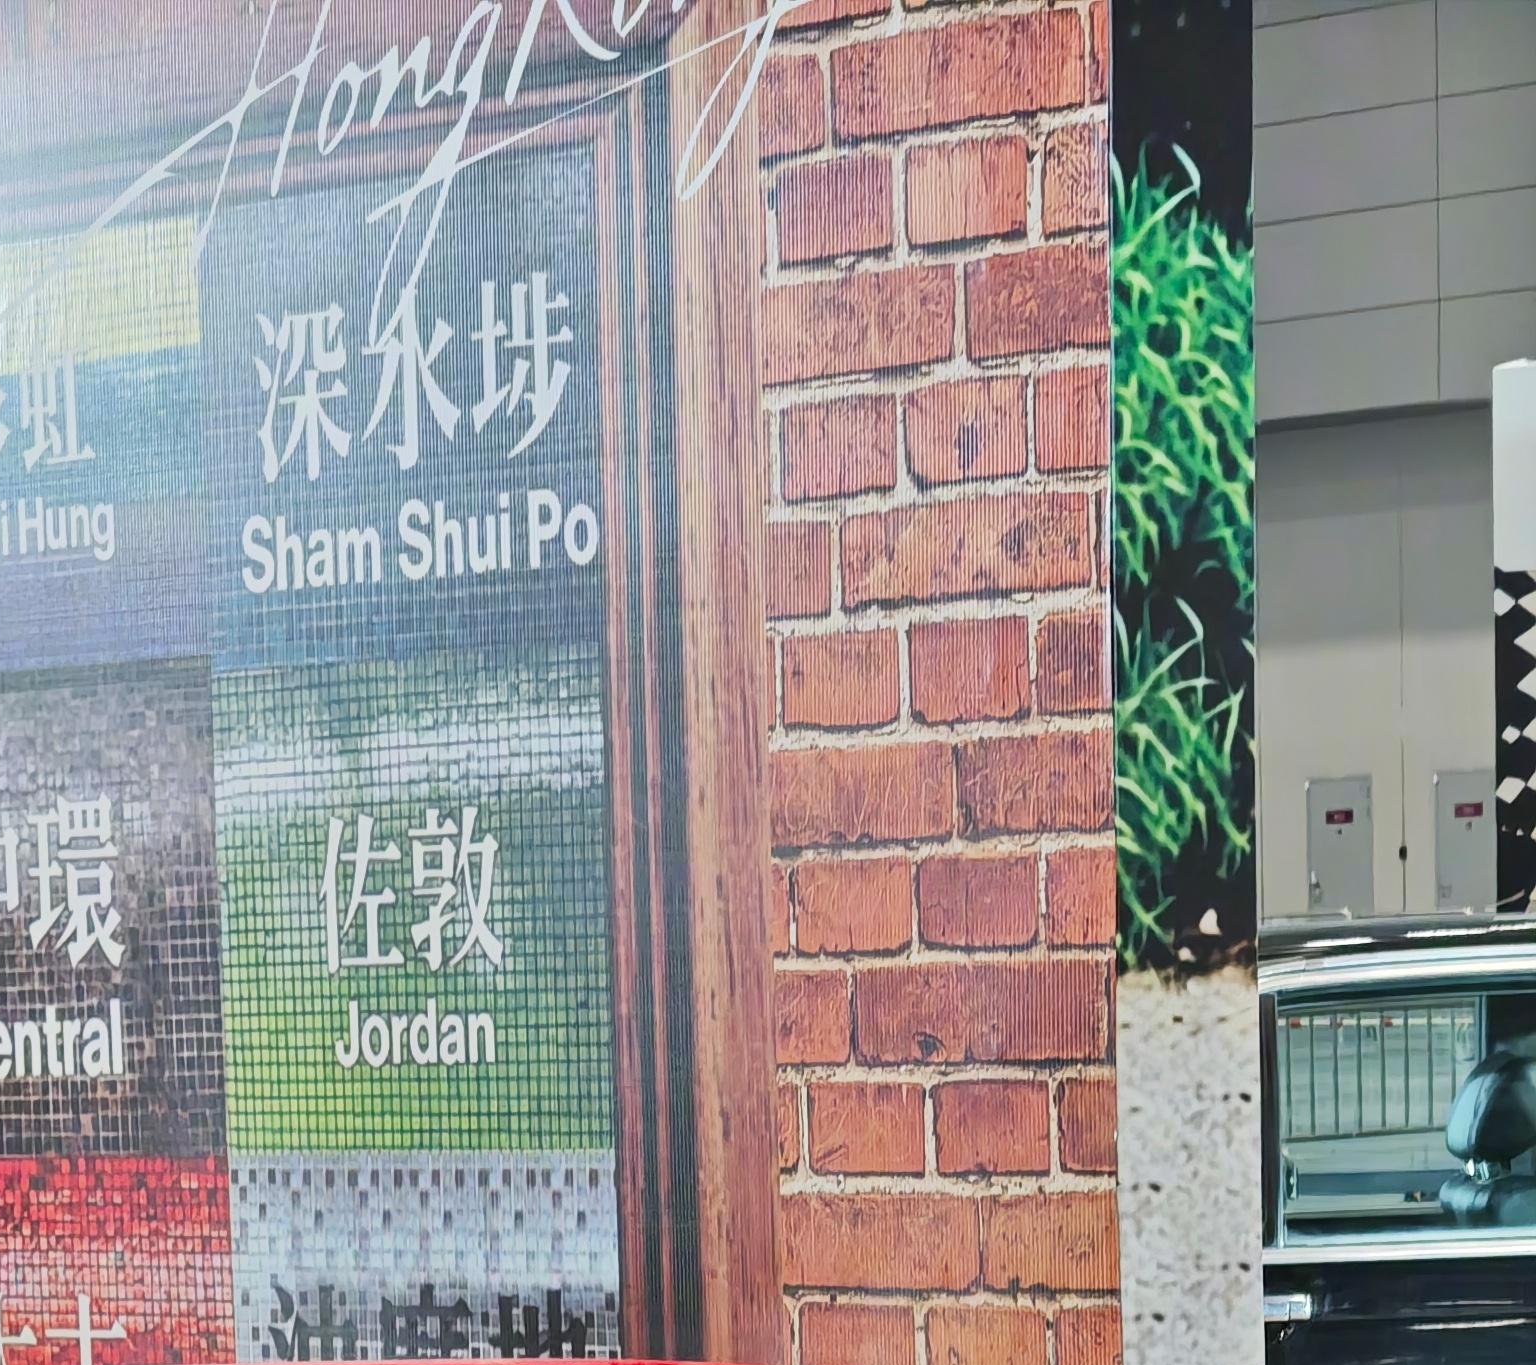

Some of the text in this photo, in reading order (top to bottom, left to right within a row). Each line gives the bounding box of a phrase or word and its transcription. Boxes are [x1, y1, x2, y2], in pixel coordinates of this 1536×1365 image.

[254, 271, 574, 483] 深水埗
[17, 497, 116, 562] Hung
[241, 489, 600, 594] Sham Shui Po
[319, 806, 504, 974] 佐敦
[335, 1000, 496, 1067] Jordan
